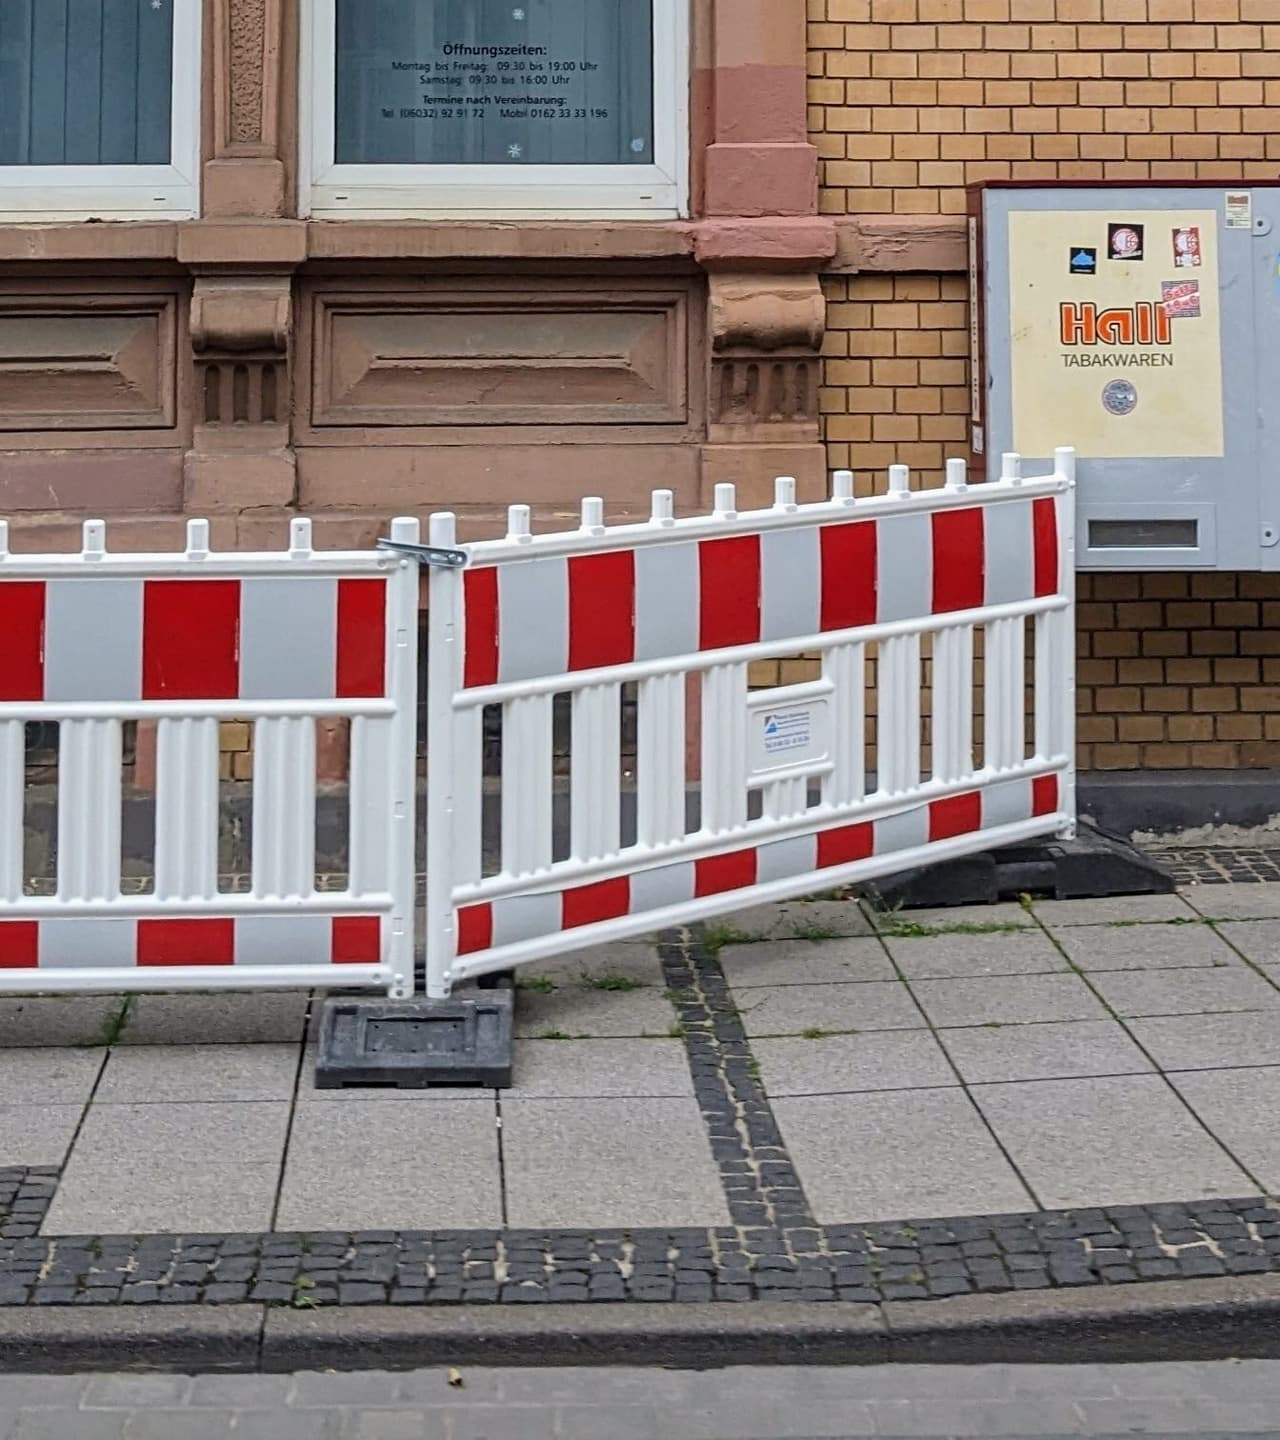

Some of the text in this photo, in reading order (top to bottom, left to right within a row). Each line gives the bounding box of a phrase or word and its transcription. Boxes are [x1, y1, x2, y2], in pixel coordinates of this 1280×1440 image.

[443, 43, 547, 58] Öffnungszeiten:
[391, 61, 430, 73] Montag
[435, 61, 449, 71] bis
[529, 62, 543, 71] bis
[580, 62, 598, 71] Uhr
[501, 75, 515, 85] bis
[552, 75, 570, 85] Uhr
[423, 95, 567, 107] Termine nach Vereinbarung:
[441, 109, 453, 118] 92
[472, 109, 485, 118] 72
[530, 108, 555, 118] 0162
[559, 109, 571, 118] 33
[575, 109, 587, 118] 33
[1060, 302, 1172, 345] Hall
[1061, 353, 1173, 367] TABAKWAREN
